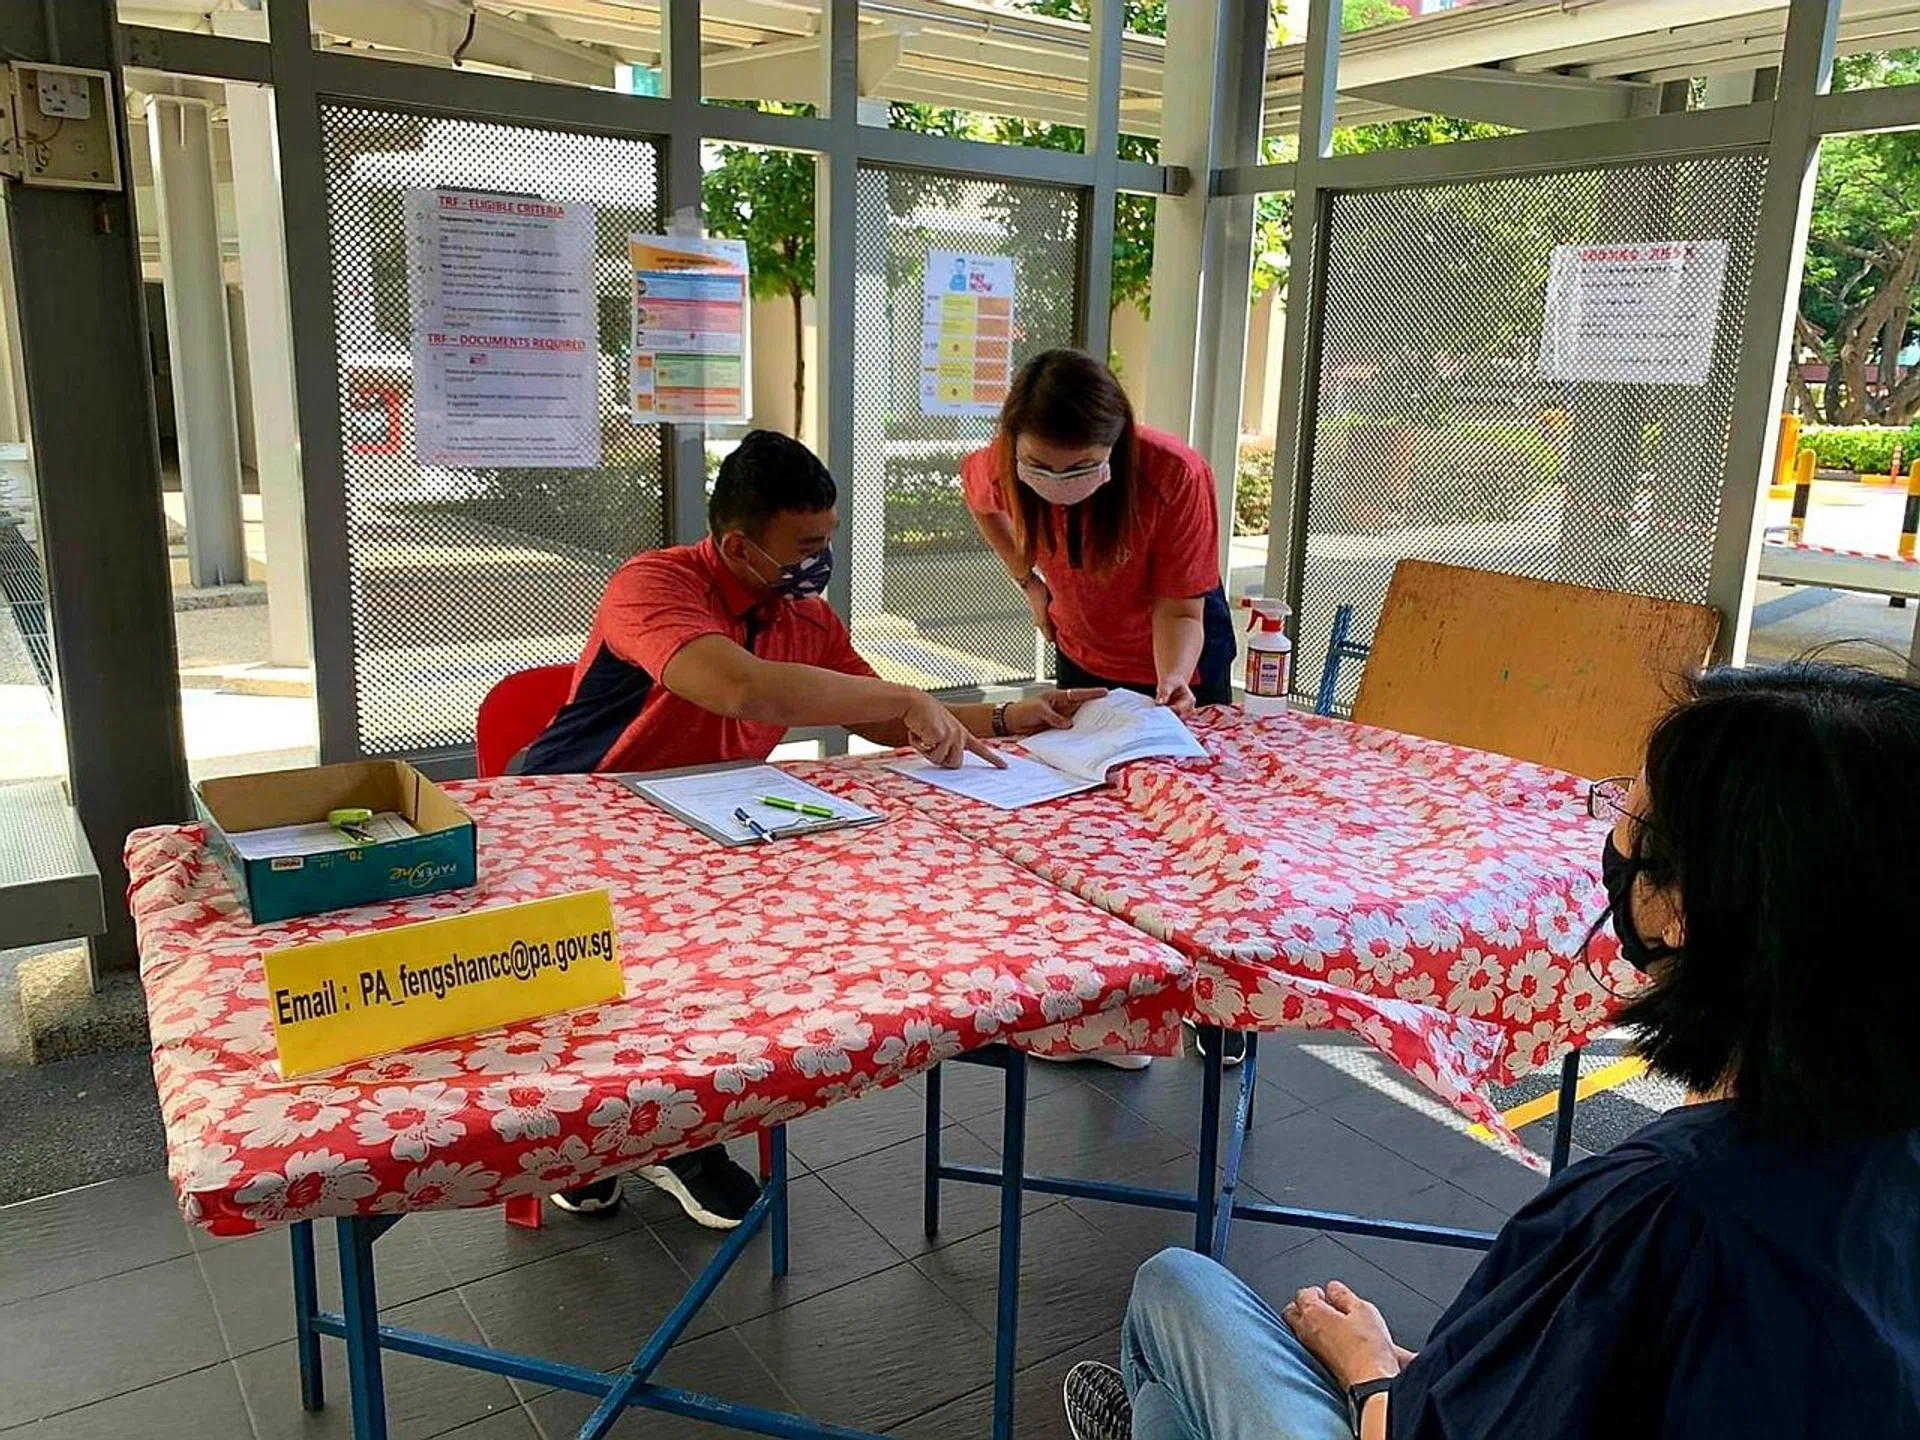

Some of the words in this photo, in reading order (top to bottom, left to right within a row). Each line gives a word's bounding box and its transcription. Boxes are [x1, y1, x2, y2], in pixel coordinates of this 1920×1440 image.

[438, 196, 458, 208] TRF
[469, 198, 514, 213] ELIGIBLE
[517, 203, 565, 217] CRITERIA
[427, 333, 447, 345] TRF
[460, 335, 530, 349] DOCUMENTS
[532, 338, 586, 351] REQUIRED
[275, 980, 337, 1025] Email
[359, 930, 613, 1007] PA_fengshancc@pa.gov.sg
